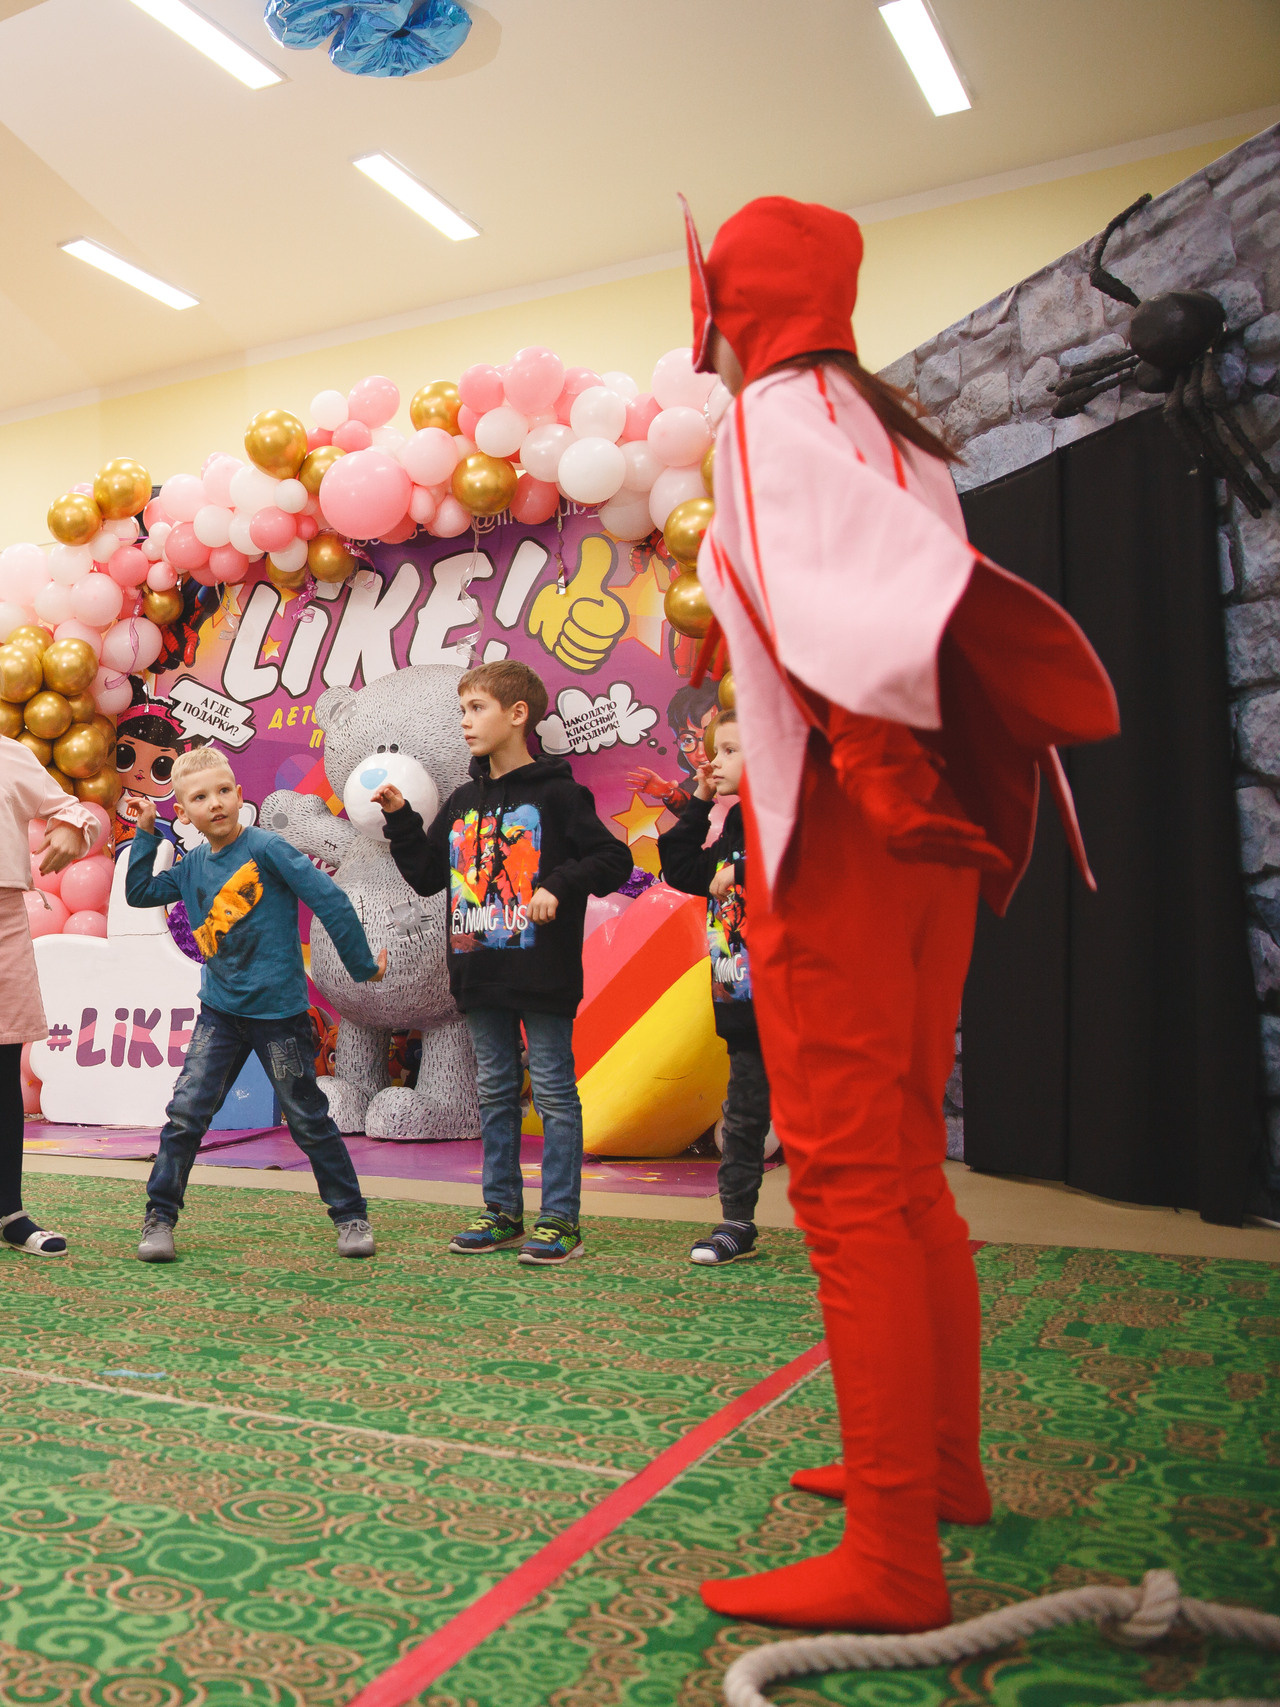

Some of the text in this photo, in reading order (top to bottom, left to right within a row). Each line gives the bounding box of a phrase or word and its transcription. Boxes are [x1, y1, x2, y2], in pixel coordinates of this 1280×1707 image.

[182, 702, 240, 736] ПОДАРКИ?
[210, 700, 232, 719] ГДЕ
[563, 701, 617, 729] НАКОЛДУЮ
[566, 711, 618, 738] КЛАССНЫЙ
[568, 720, 620, 747] ПРАЗДНИК!
[452, 903, 528, 934] AMONG US
